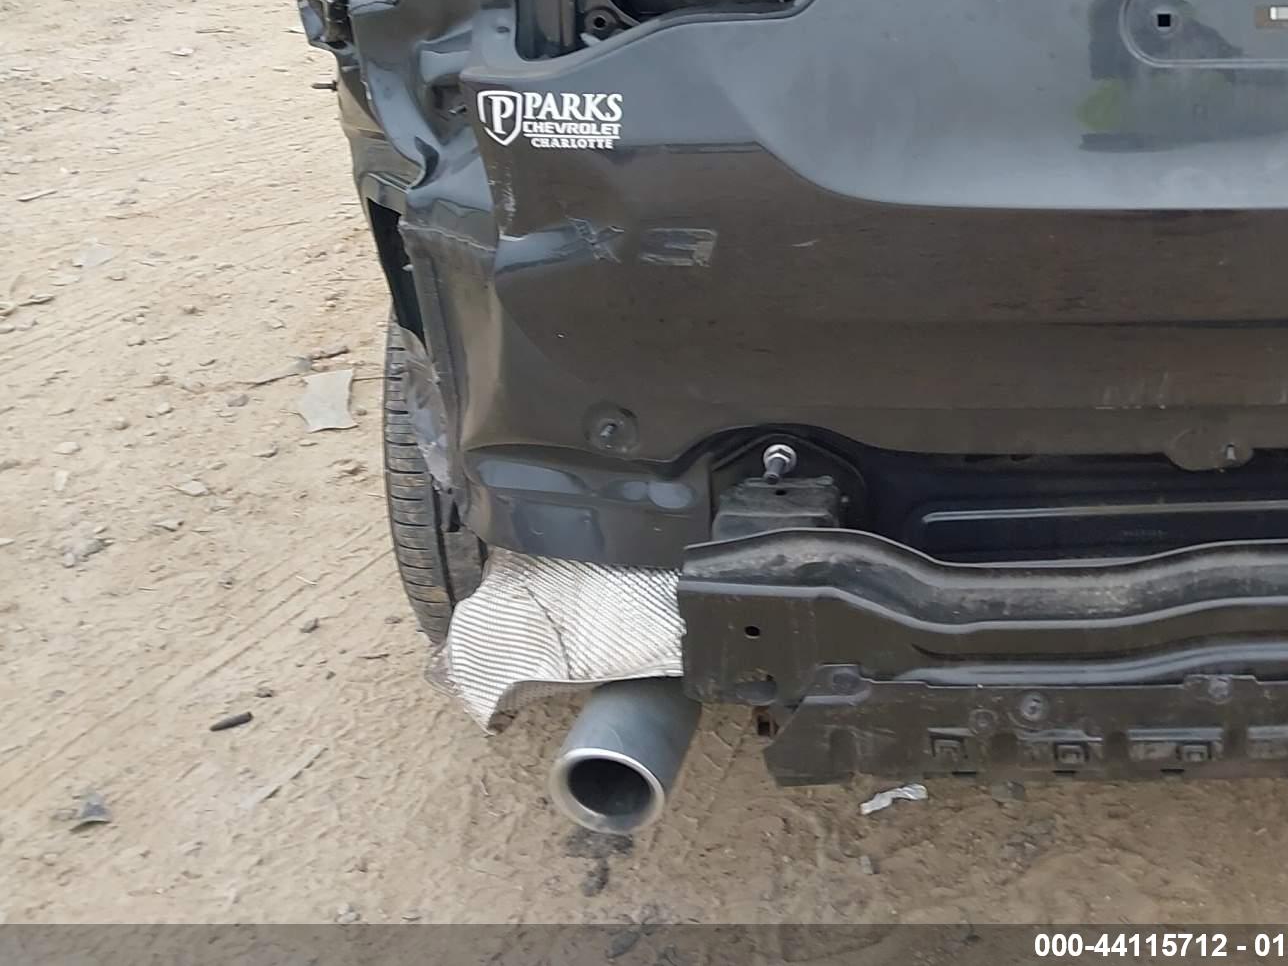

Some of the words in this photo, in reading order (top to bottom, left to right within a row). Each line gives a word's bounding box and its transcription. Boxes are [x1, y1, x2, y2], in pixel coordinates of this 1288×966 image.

[488, 95, 515, 134] P
[523, 92, 623, 121] PARKS
[523, 121, 622, 135] CHEVROLET
[531, 138, 614, 149] CHARLOTTE
